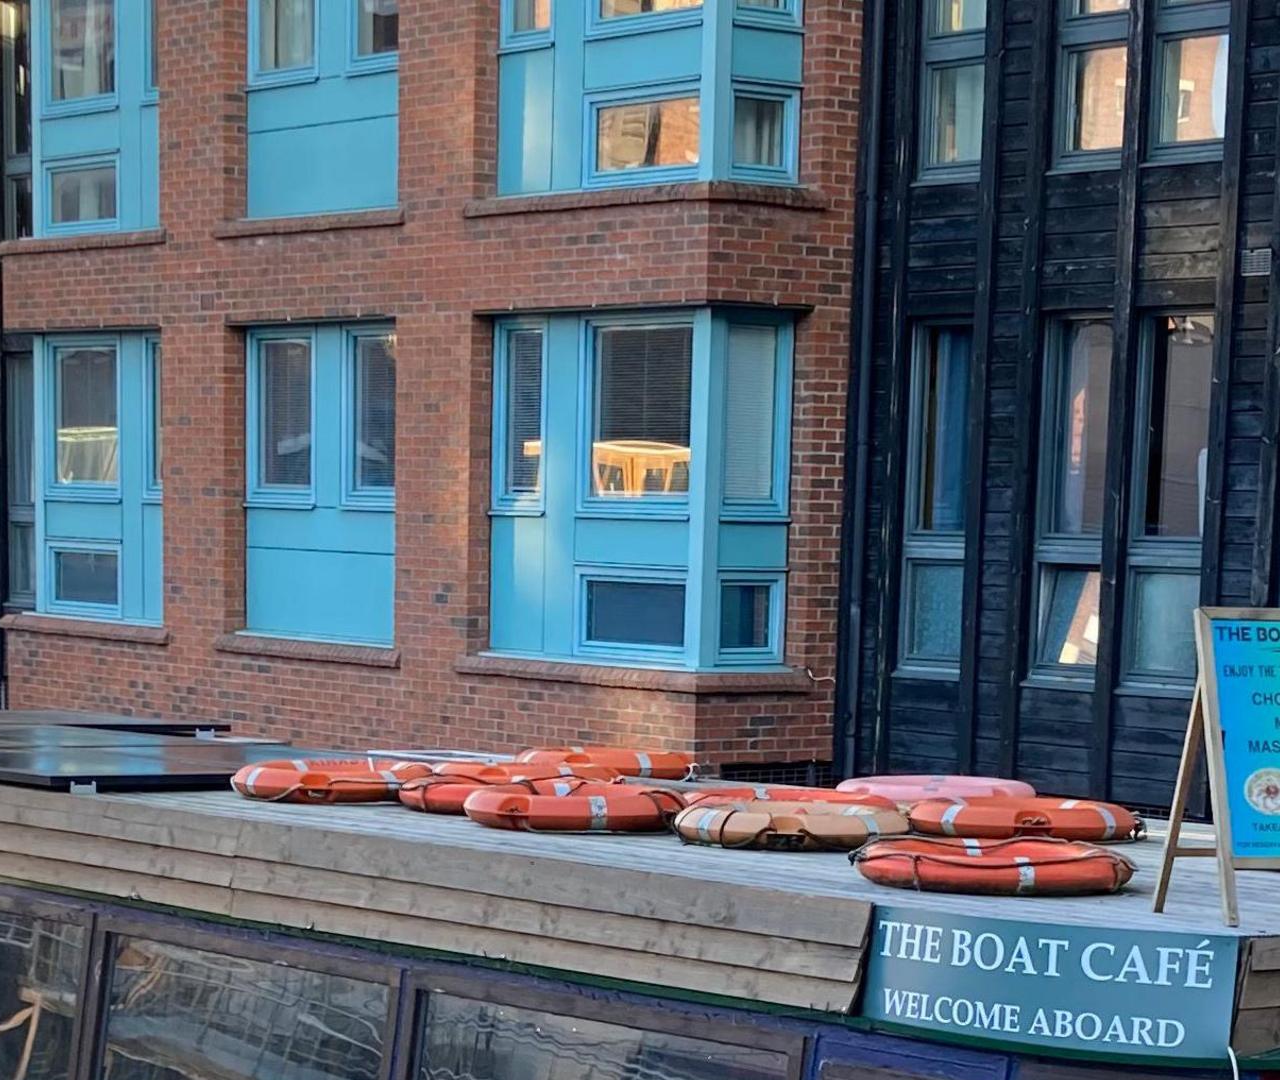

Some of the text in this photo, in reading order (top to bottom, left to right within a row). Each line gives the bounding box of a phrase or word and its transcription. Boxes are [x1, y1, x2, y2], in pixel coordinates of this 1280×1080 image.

[1216, 626, 1251, 642] THE
[1223, 664, 1256, 678] ENJOY
[1258, 665, 1276, 678] THE
[879, 919, 1216, 989] THE BOAT CAFÉ
[882, 988, 1186, 1048] WELCOME ABOARD
